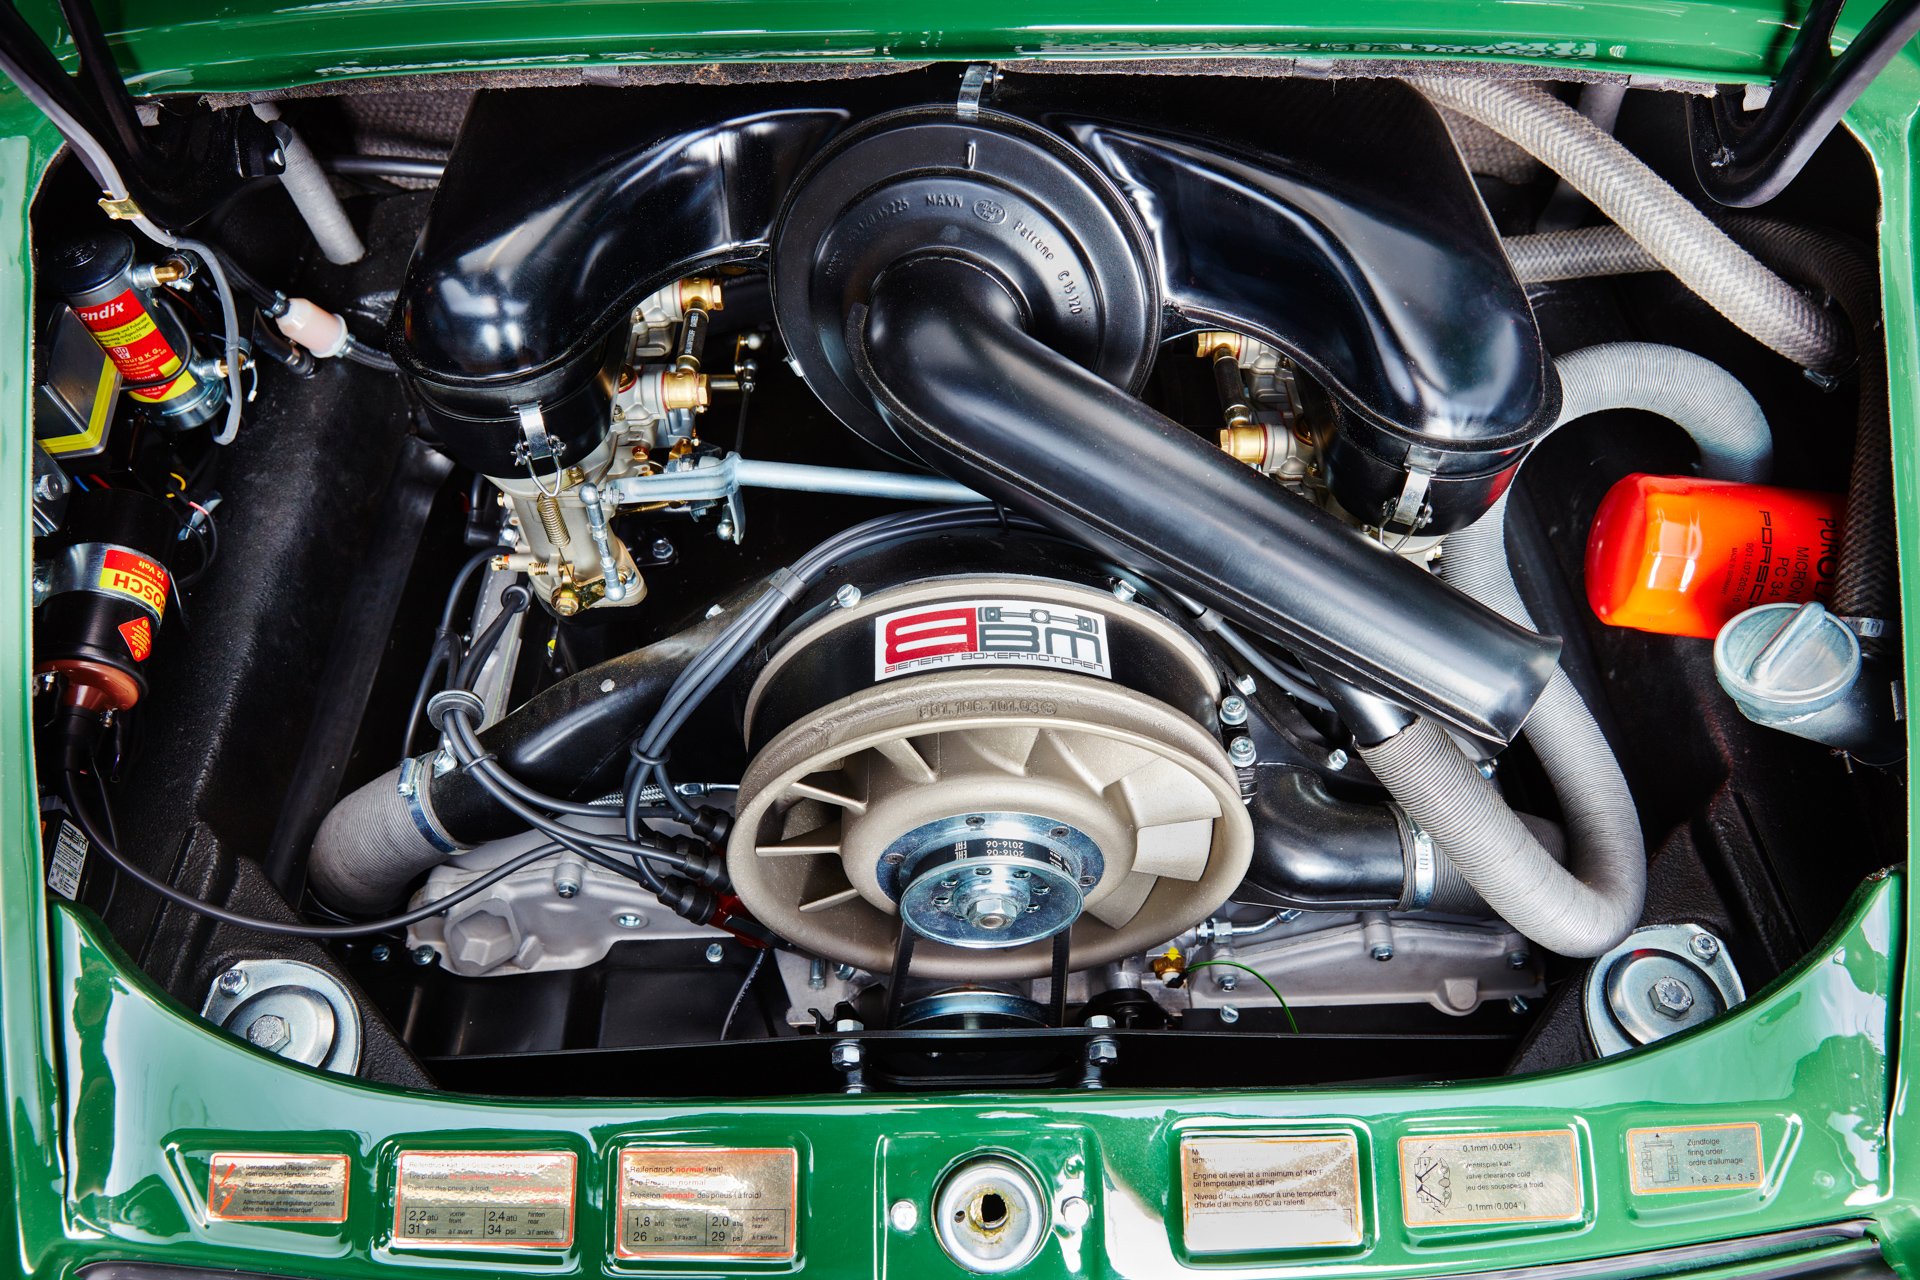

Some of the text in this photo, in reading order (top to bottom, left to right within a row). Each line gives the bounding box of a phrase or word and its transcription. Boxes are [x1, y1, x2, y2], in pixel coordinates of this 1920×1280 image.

[926, 194, 964, 208] MANN
[1013, 221, 1056, 262] Patrone
[1058, 270, 1070, 281] C
[1068, 295, 1082, 315] 120
[79, 302, 125, 322] endix
[131, 568, 152, 581] Germany
[138, 560, 164, 582] 12 Volt
[1768, 557, 1790, 597] PC 34
[113, 573, 166, 615] BOSCH
[885, 652, 1105, 674] BIENERT BOXER-MOTOREN
[986, 841, 1024, 850] 2016-06
[1687, 1138, 1720, 1147] Zündfolge
[1688, 1149, 1704, 1157] firing
[1708, 1157, 1744, 1166] d'allumage
[1193, 1172, 1218, 1181] Engine
[1483, 1172, 1515, 1180] clearance
[1202, 1180, 1246, 1189] temperature
[1466, 1184, 1475, 1192] jeu
[630, 1192, 661, 1200] Pression
[1194, 1193, 1217, 1201] Niveau
[1283, 1198, 1306, 1206] ralenti
[408, 1210, 427, 1223] 2,2
[427, 1213, 439, 1221] atü
[488, 1211, 506, 1224] 2,4
[506, 1214, 518, 1222] atü
[634, 1217, 651, 1229] 1,8
[654, 1219, 665, 1227] atü
[711, 1217, 729, 1229] 2,0
[732, 1219, 744, 1227] atü
[408, 1224, 421, 1235] 31
[425, 1228, 437, 1236] psi
[488, 1224, 502, 1235] 34
[505, 1229, 517, 1237] psi
[633, 1232, 647, 1242] 26
[654, 1235, 664, 1243] psi
[711, 1232, 725, 1242] 29
[732, 1235, 743, 1243] psi
